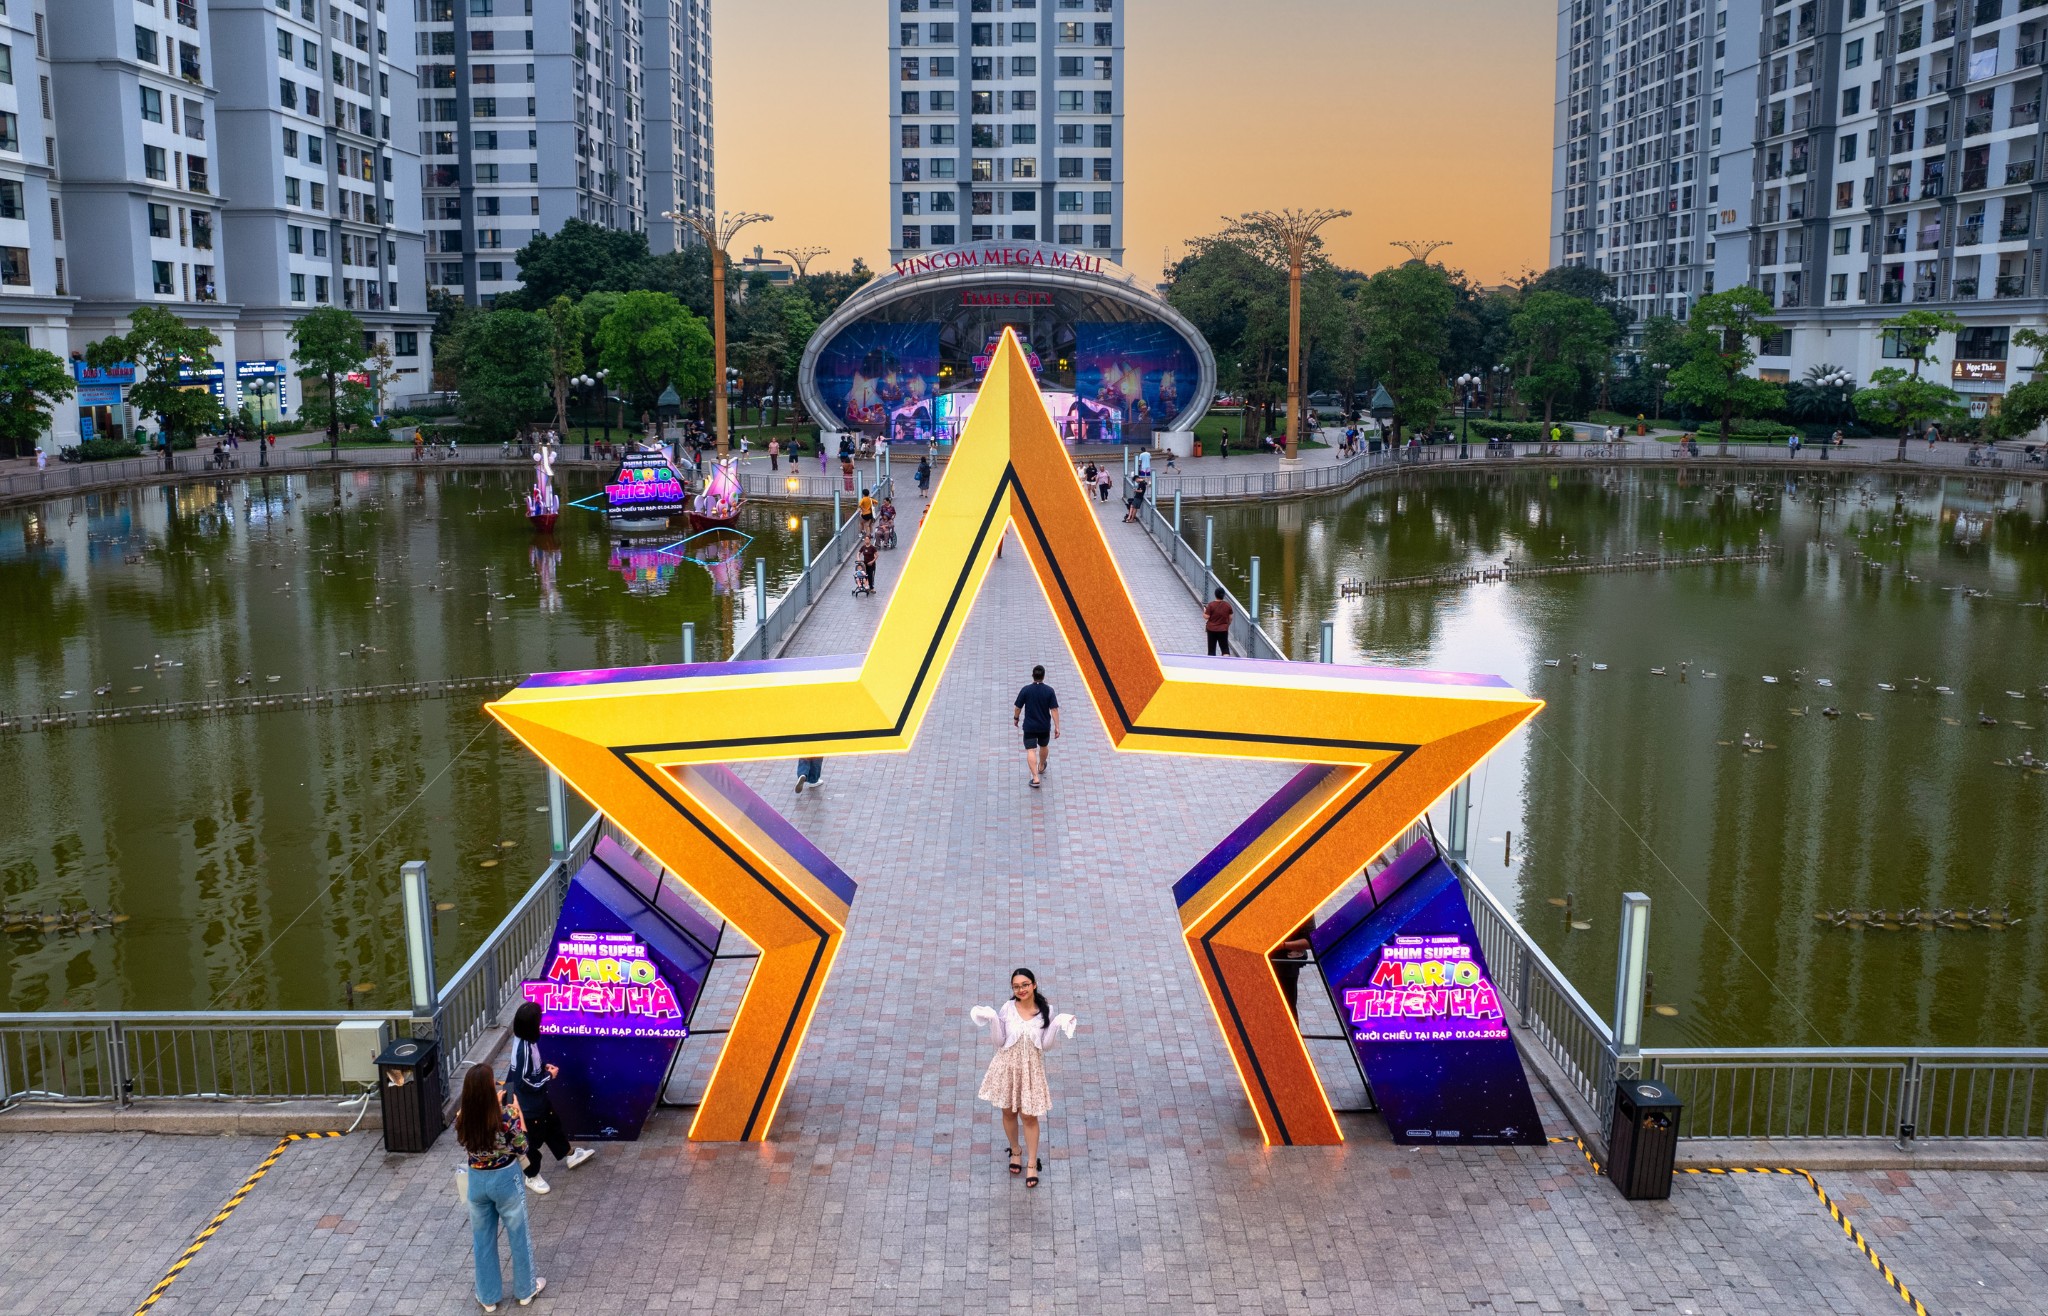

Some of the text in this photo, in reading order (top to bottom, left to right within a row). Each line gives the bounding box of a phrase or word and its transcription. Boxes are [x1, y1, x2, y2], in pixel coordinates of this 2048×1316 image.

[893, 248, 1105, 277] VINCOM MEGA MALL
[618, 467, 672, 483] MARIO
[605, 476, 685, 503] THIÊN HÀ
[558, 943, 645, 957] PHIM SUPER
[1384, 946, 1471, 960] PHIM SUPER
[548, 955, 656, 985] MARIO
[1371, 960, 1480, 987] MARIO
[523, 977, 682, 1019] THIÊN HÀ
[1346, 978, 1504, 1023] THIÊN HÀ
[562, 1024, 590, 1034] CHIẾU
[594, 1027, 610, 1036] TẠI
[612, 1028, 632, 1036] RẠP
[634, 1028, 687, 1037] 01.04.2026
[1355, 1029, 1508, 1041] KHỞI CHIẾU TẠI RẠP 01.04.2026
